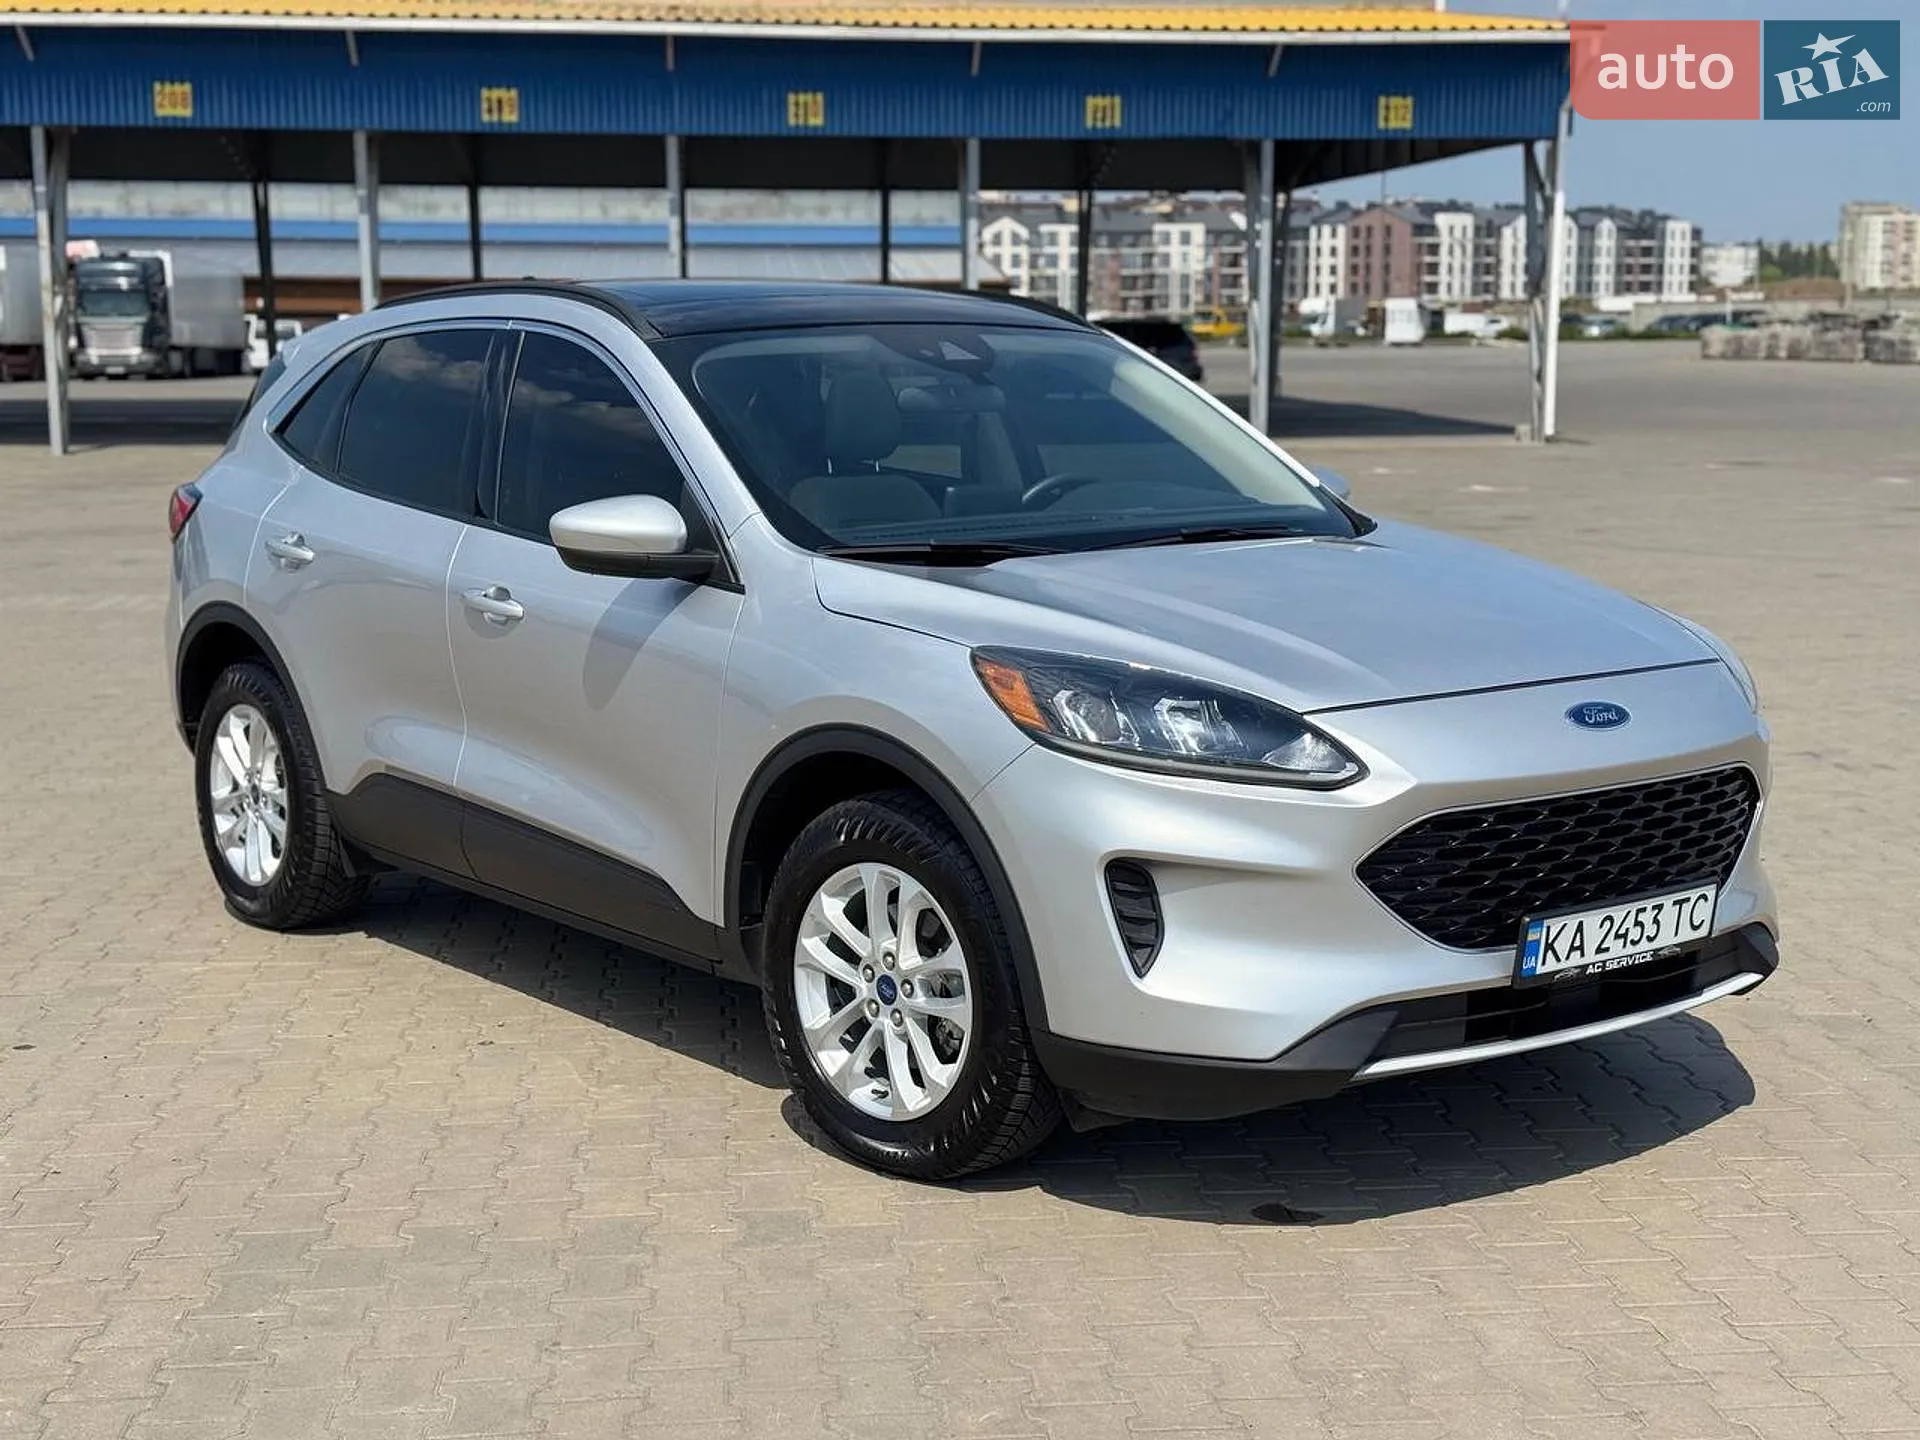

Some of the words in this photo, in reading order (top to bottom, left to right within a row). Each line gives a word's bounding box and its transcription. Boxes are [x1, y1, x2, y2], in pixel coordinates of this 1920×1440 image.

[1583, 706, 1618, 723] Ford
[1541, 920, 1586, 966] KA
[1594, 902, 1664, 956] 2453
[1672, 893, 1710, 937] TC
[1523, 957, 1536, 969] UA
[1586, 962, 1602, 975] AC
[1605, 951, 1654, 971] SERVICE
